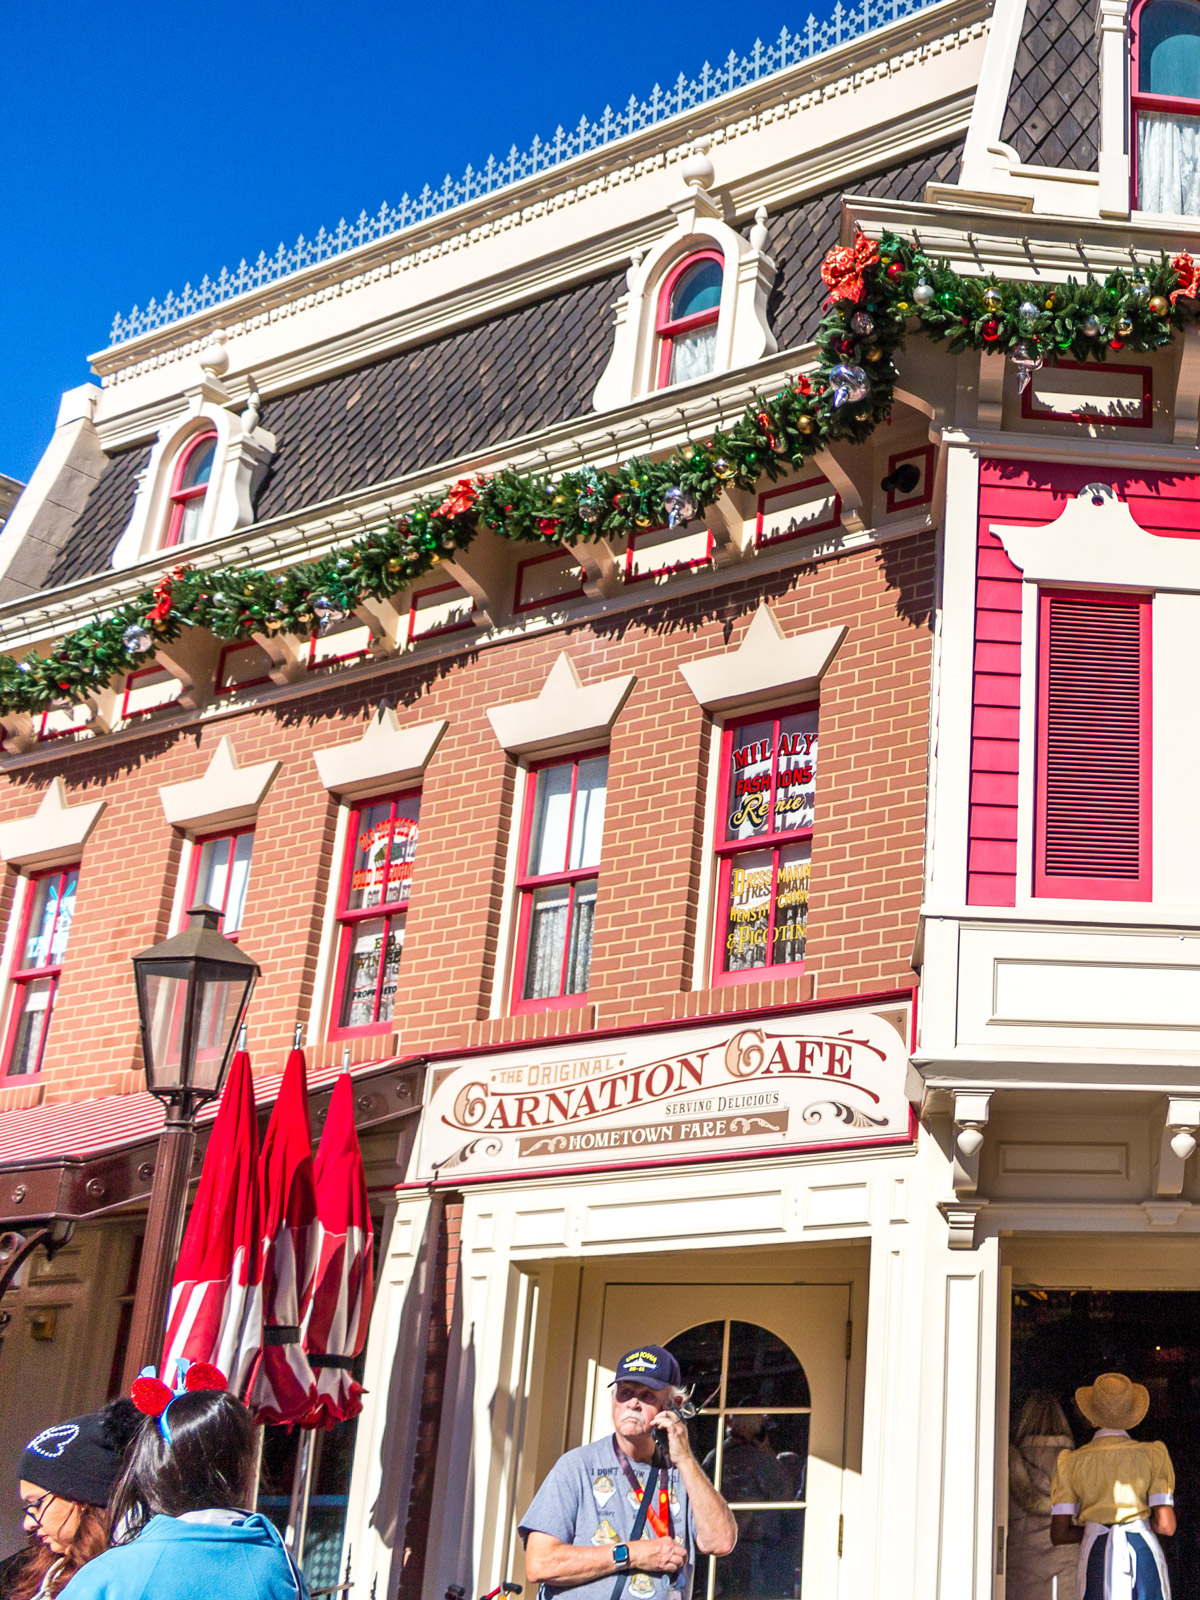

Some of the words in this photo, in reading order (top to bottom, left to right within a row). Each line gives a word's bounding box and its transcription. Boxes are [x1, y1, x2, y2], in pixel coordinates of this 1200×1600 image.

[736, 766, 812, 797] FASHIONS
[737, 923, 807, 953] PICOTIN
[454, 1053, 709, 1128] CARNATION
[724, 1028, 856, 1080] CAFÉ
[500, 1067, 522, 1085] THE
[527, 1058, 614, 1087] ORIGINAL
[664, 1100, 712, 1115] SERVING
[717, 1091, 780, 1112] DELICIOUS
[568, 1125, 674, 1151] HOMETOWN
[680, 1121, 727, 1139] FARE
